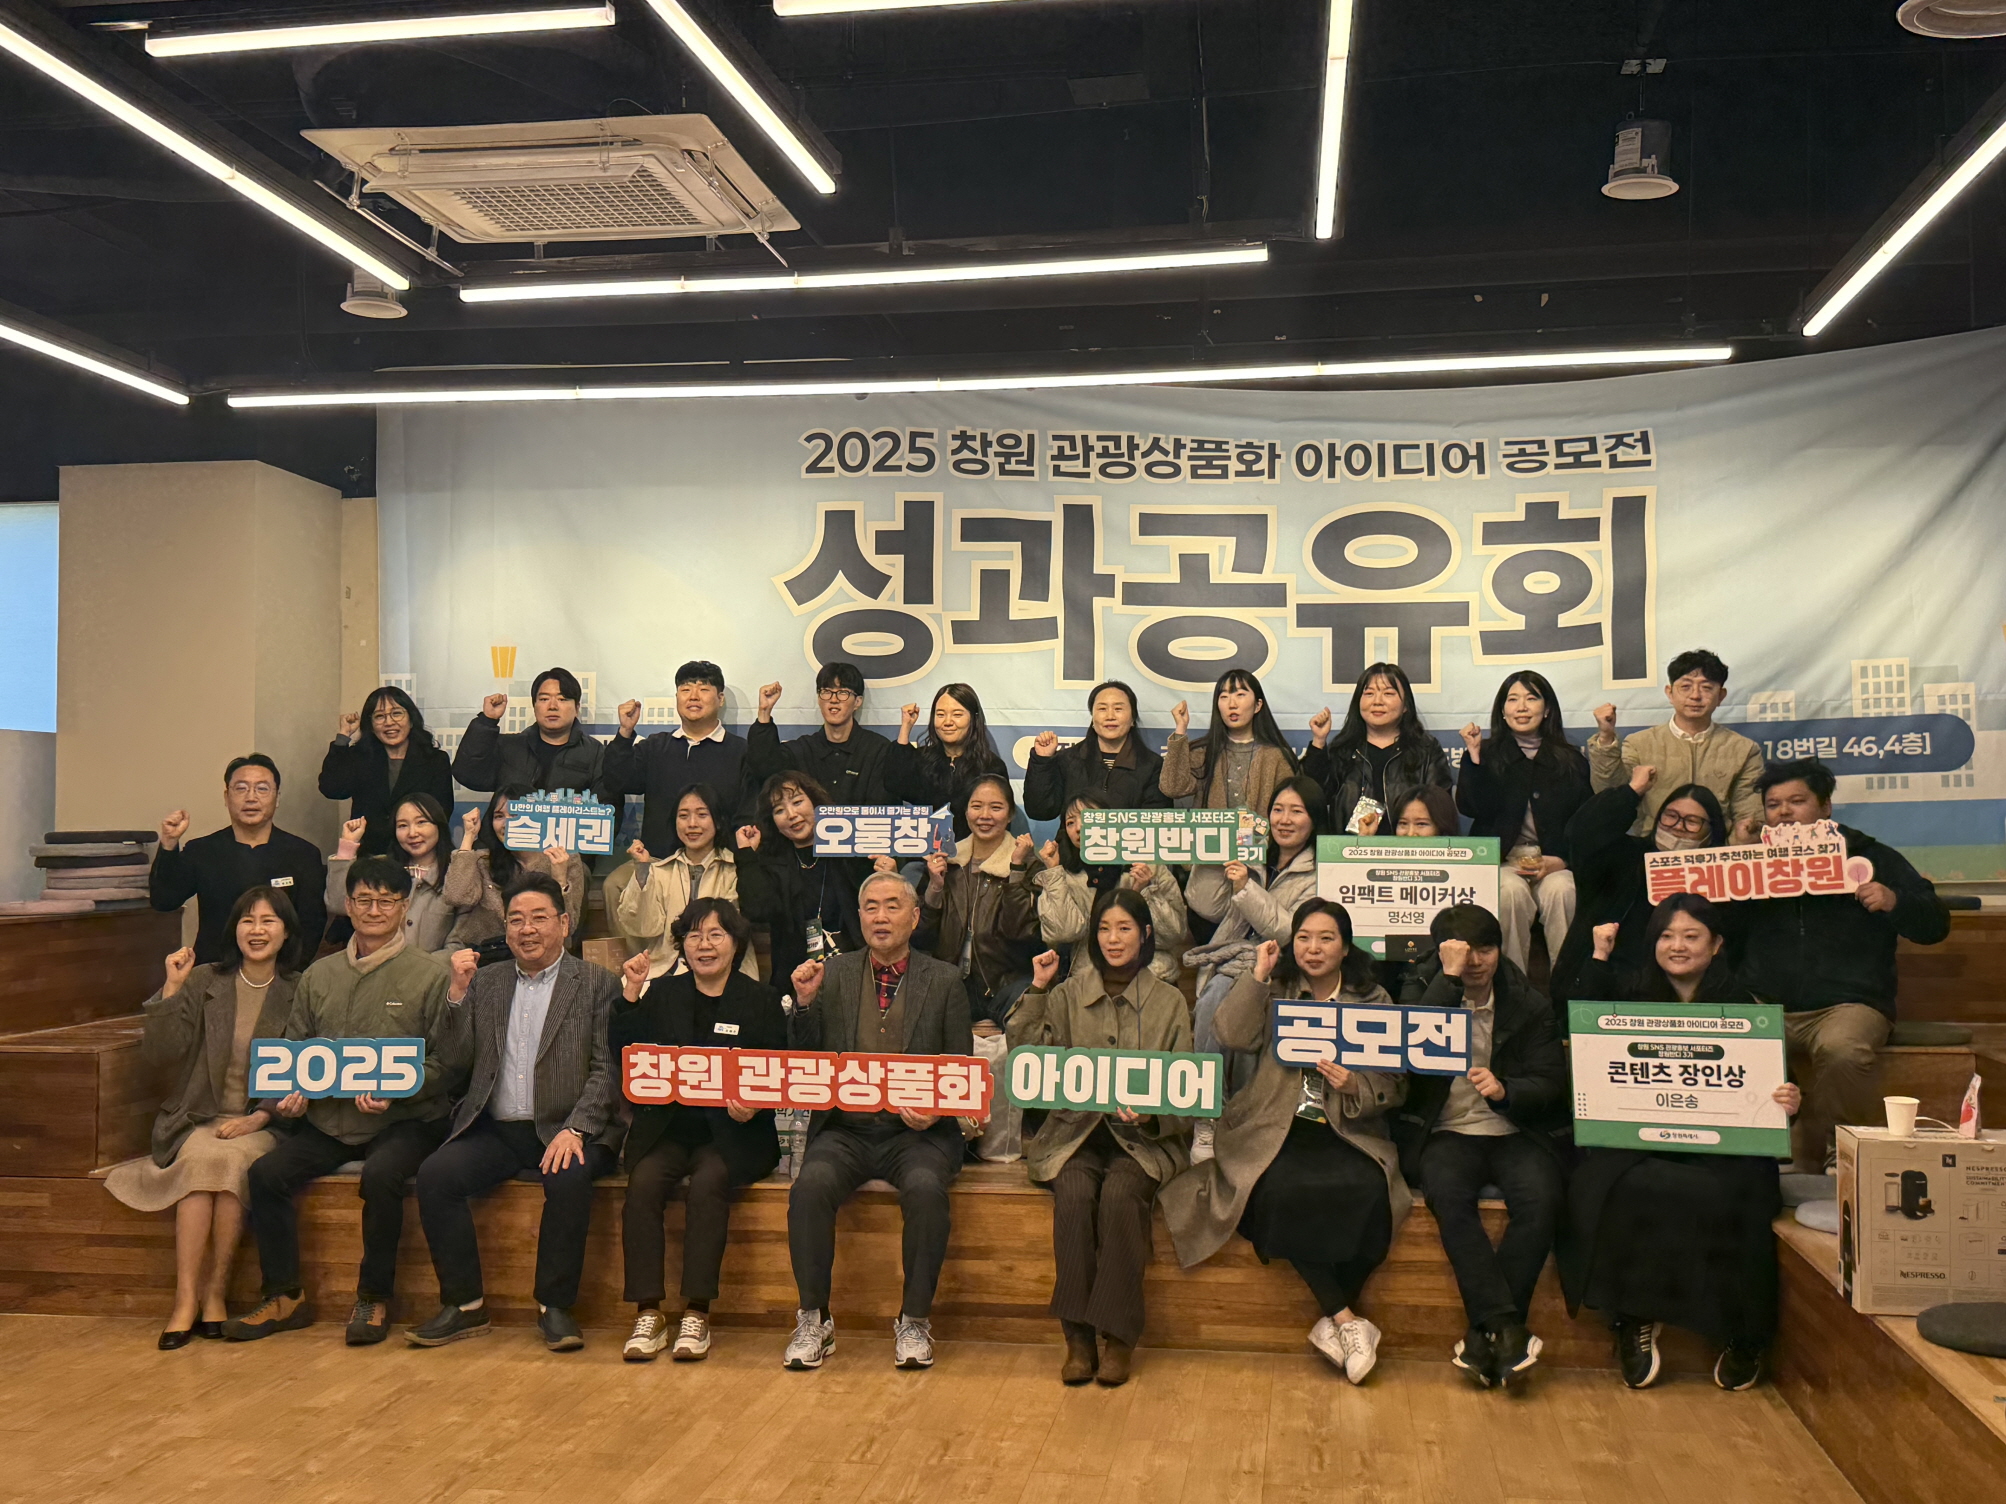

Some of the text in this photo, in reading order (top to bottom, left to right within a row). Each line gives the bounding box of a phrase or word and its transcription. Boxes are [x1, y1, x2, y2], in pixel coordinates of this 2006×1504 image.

[804, 430, 1651, 479] 2025 창원 관광상품화 아이디어 공모전
[783, 496, 1646, 684] 성과공유회
[1763, 732, 1930, 760] 18번길 46,4층]
[510, 803, 534, 812] 나만의
[819, 806, 859, 815] 오만원으로
[913, 806, 929, 815] 창원
[1083, 812, 1235, 824] 창원 SNS 관광홍보 서포터즈
[507, 816, 611, 852] 슬세권
[816, 817, 931, 854] 오둘창
[1084, 826, 1230, 861] 창원반디
[1237, 847, 1264, 861] 3기
[1349, 849, 1368, 857] 2025
[1419, 850, 1445, 858] 아이디어
[1447, 850, 1467, 858] 공모전
[1649, 843, 1841, 867] 스포츠 덕후가 추천하는 여행 코스 찾기
[1650, 856, 1845, 901] 플레이창원
[1339, 884, 1476, 906] 임팩트 메이커상
[1388, 911, 1425, 925] 명선영
[1277, 1004, 1467, 1071] 공모전
[1605, 1018, 1744, 1030] 2025 창원 관광상품화 아이디어 공모전
[256, 1045, 418, 1092] 2025
[629, 1051, 987, 1110] 창원 관광상품화
[1011, 1052, 1215, 1109] 아이디어
[1607, 1060, 1747, 1088] 콘텐츠 장인상
[1655, 1093, 1699, 1109] 이은송
[1899, 1270, 1946, 1279] NESPRESSO
